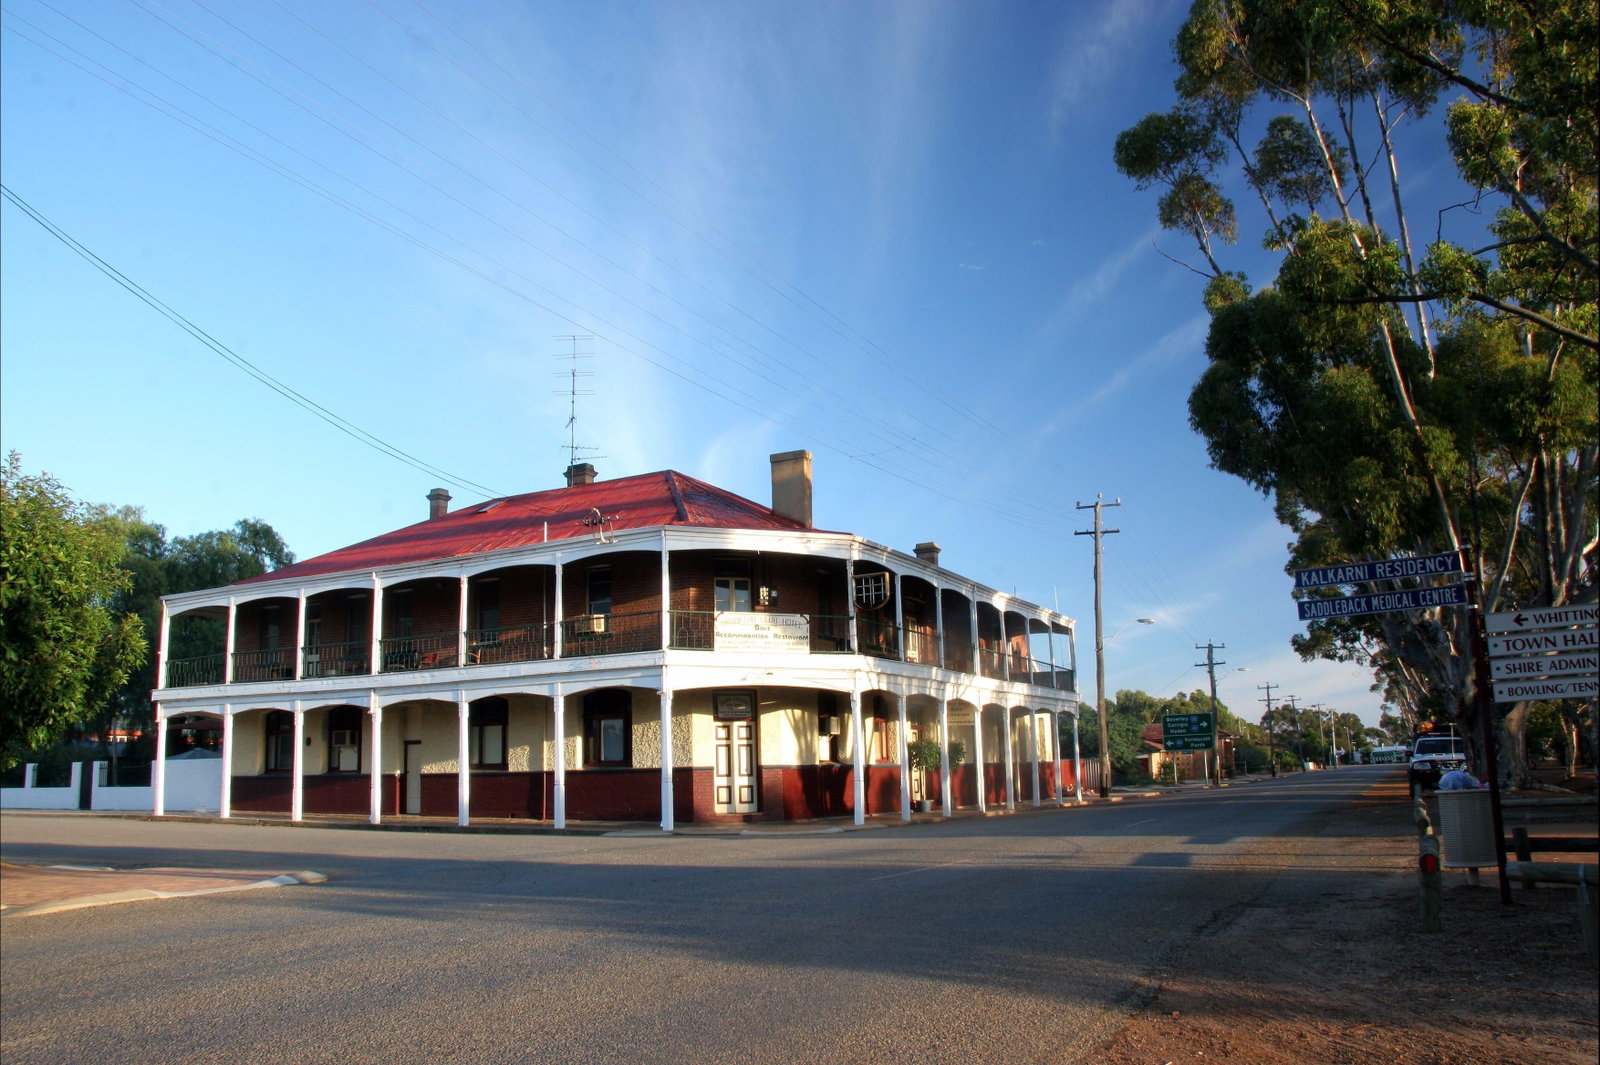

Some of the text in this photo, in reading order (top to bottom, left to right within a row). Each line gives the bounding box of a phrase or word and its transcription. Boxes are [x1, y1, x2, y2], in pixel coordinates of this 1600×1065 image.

[1301, 556, 1454, 586] KALKARNI RESIDENCY
[1304, 587, 1457, 617] SADDLEBACK MEDICAL CENTRE
[1502, 635, 1556, 651] TOWN
[1505, 657, 1597, 674] SHIRE ADMIN
